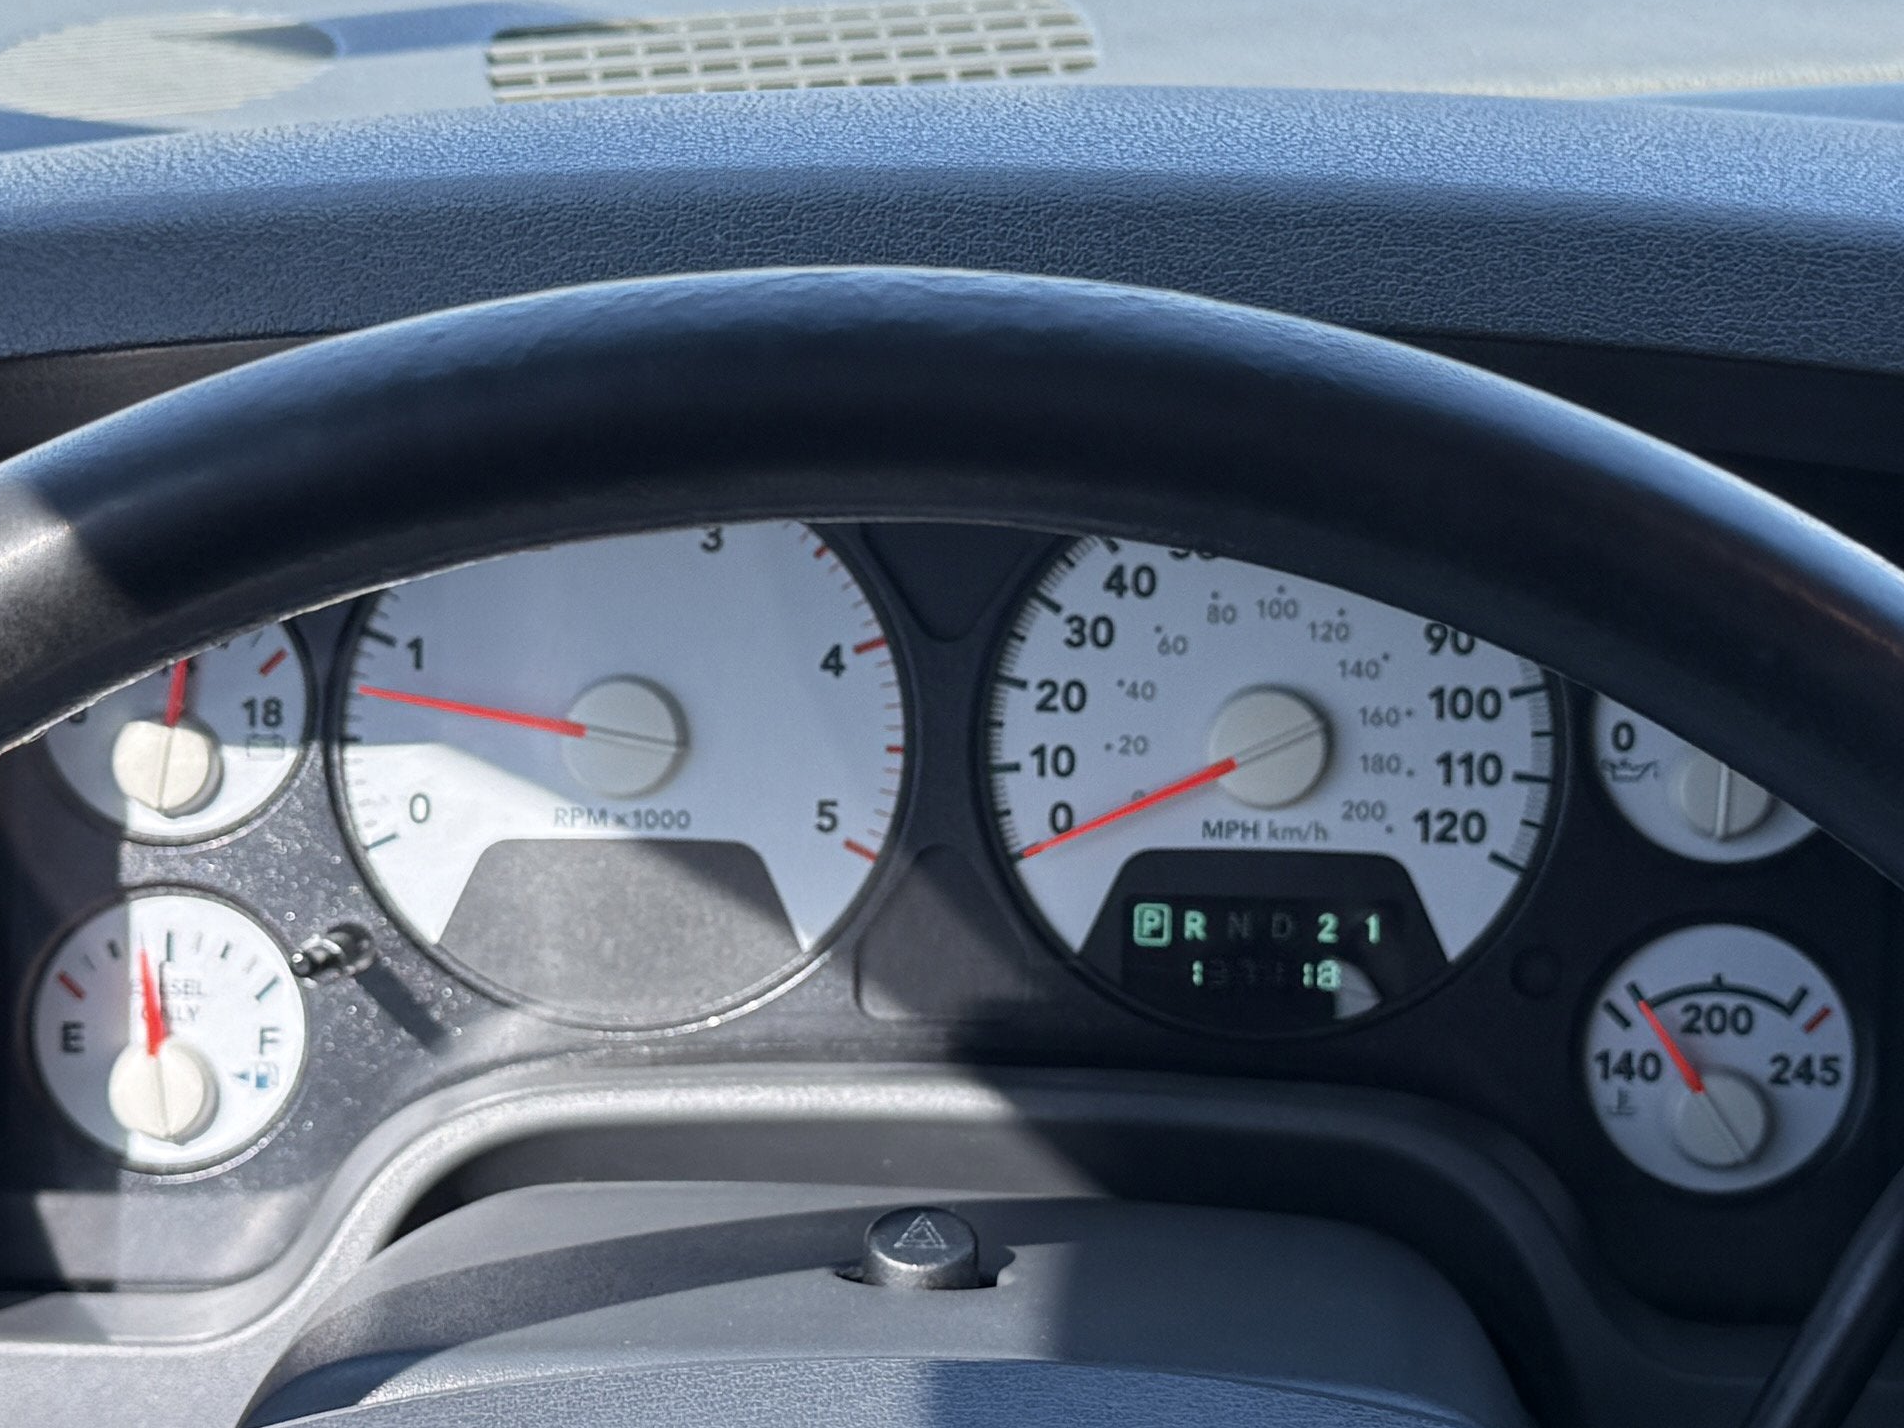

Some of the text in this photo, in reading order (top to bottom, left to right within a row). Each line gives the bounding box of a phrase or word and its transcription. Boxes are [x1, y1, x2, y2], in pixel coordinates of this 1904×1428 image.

[700, 526, 724, 553] 3
[1103, 564, 1156, 599] 40
[1206, 604, 1237, 625] 80
[1256, 598, 1299, 620] 100
[1063, 614, 1114, 649] 30
[1156, 635, 1189, 656] 60
[1308, 621, 1350, 643] 120
[1424, 622, 1476, 656] 90
[407, 636, 424, 670] 1
[820, 644, 846, 677] 4
[1338, 659, 1380, 680] 140
[1035, 679, 1087, 713] 20
[1125, 680, 1156, 701] 40
[1428, 685, 1502, 721] 100
[241, 697, 283, 728] 18
[1359, 705, 1400, 727] 160
[1118, 734, 1149, 756] 20
[1612, 721, 1636, 752] 0
[1030, 743, 1076, 778] 10
[1359, 753, 1401, 775] 180
[1436, 752, 1503, 787] 110
[409, 793, 431, 824] 0
[553, 807, 609, 828] RPM
[816, 800, 839, 833] 5
[1049, 801, 1073, 835] 0
[1341, 799, 1386, 822] 200
[1201, 819, 1328, 842] MPH km/h
[1413, 808, 1487, 845] 120
[1184, 909, 1207, 941] R
[1317, 912, 1339, 944] 2
[1364, 913, 1381, 944] 1
[1681, 1002, 1753, 1035] 200
[61, 1022, 84, 1053] E
[259, 1025, 280, 1054] F
[1595, 1048, 1663, 1082] 140
[1769, 1052, 1841, 1086] 245
